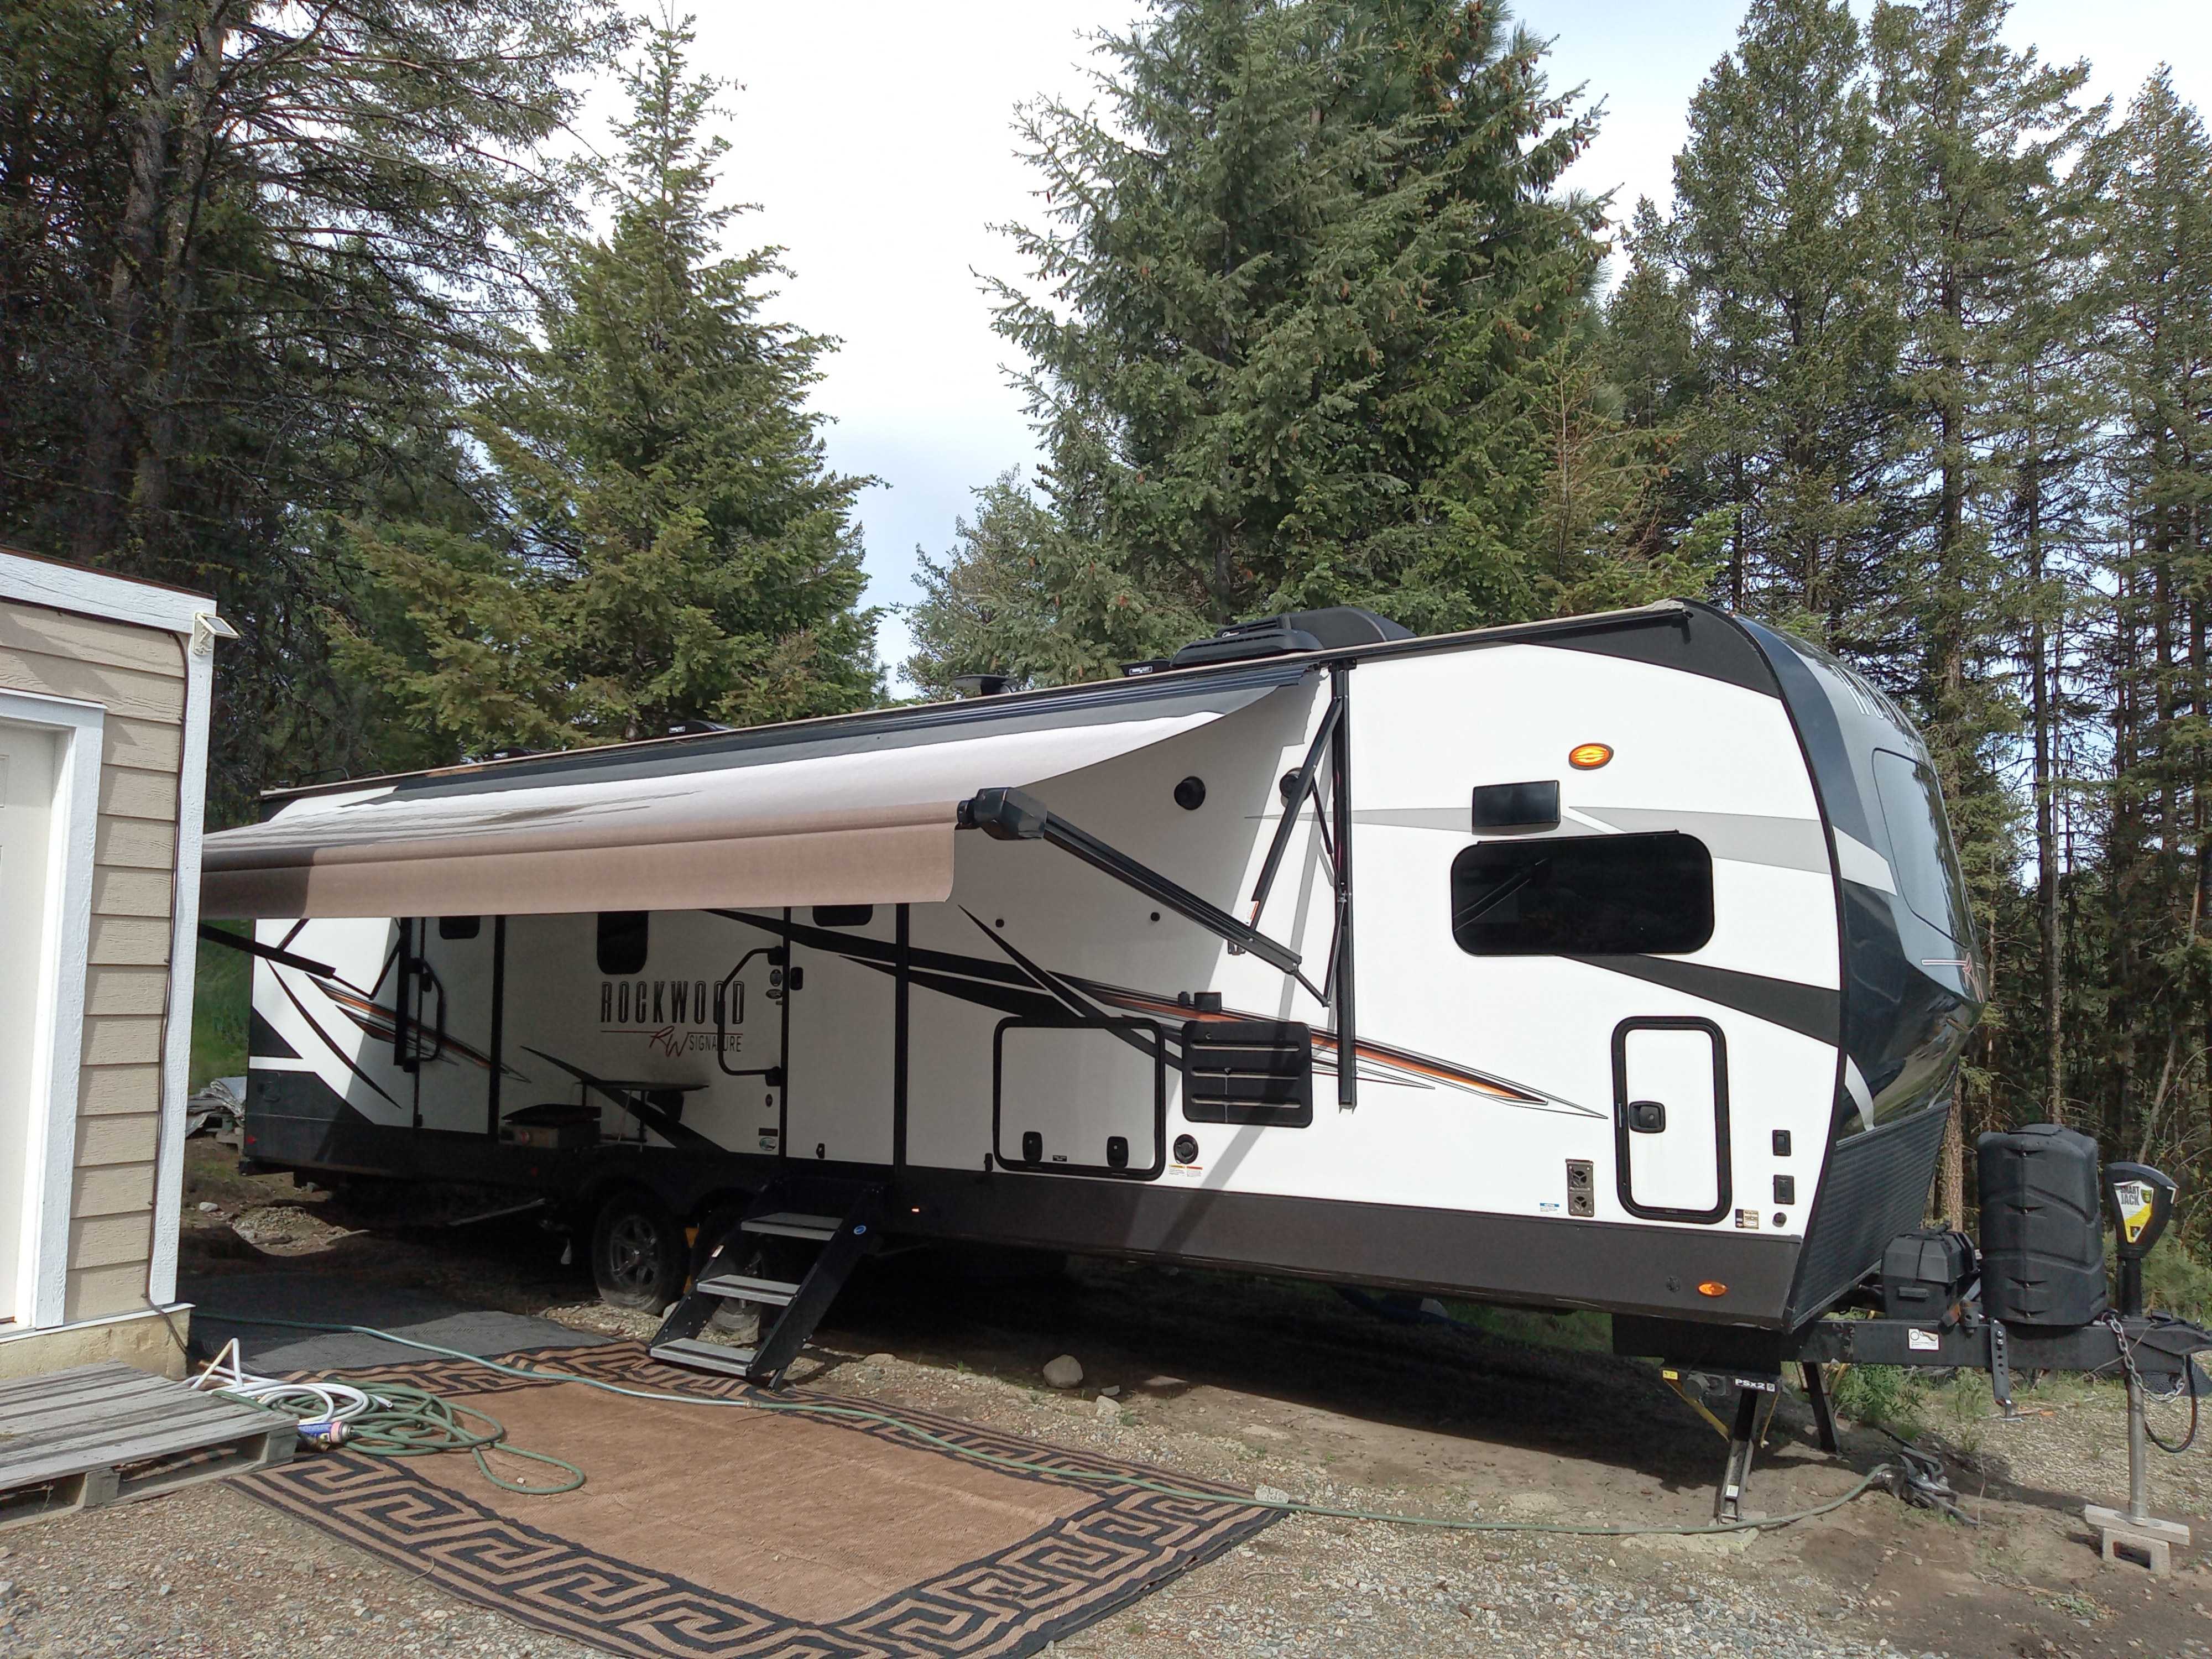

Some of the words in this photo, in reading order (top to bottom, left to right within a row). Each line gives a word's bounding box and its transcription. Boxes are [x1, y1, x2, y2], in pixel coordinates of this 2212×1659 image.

[689, 1034, 742, 1052] SIGNAURE
[2120, 1185, 2140, 1195] SMART
[2121, 1193, 2140, 1206] JACK
